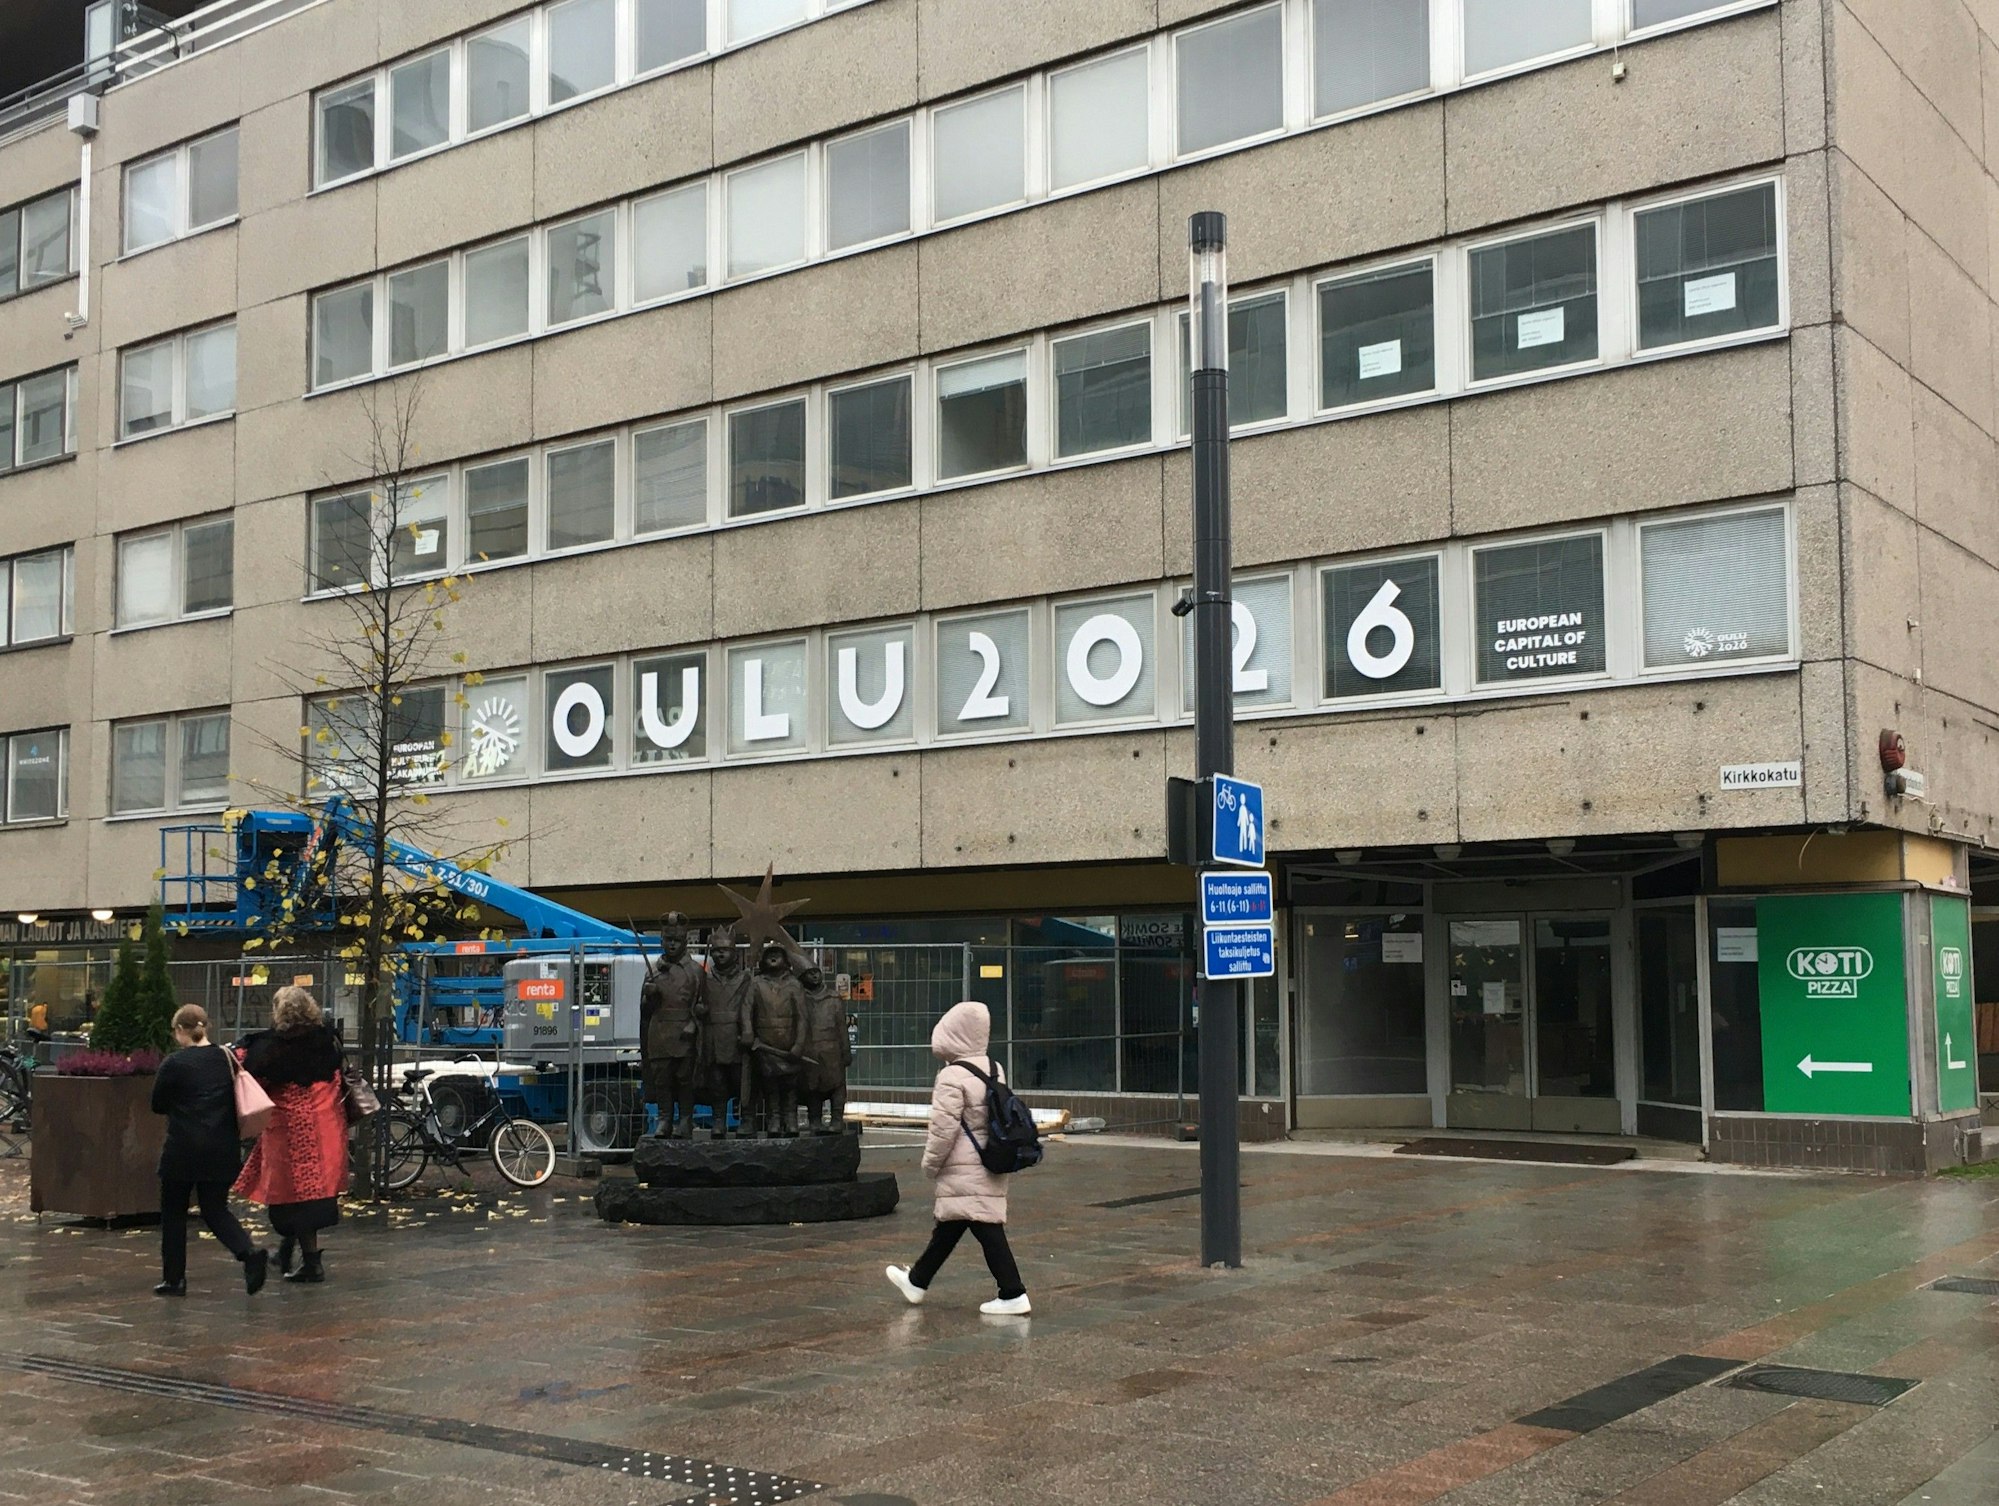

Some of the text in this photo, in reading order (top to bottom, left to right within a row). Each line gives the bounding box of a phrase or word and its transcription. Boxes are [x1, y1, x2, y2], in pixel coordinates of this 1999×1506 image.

[1497, 612, 1582, 634] EUROPEAN
[1494, 631, 1586, 652] CAPITAL OF
[1717, 632, 1747, 642] OULU
[1718, 640, 1748, 651] 2026
[1506, 651, 1577, 670] CULTURE
[1723, 768, 1798, 784] Kirkkokatu
[1208, 883, 1267, 897] Huoltoajo sallittu
[1210, 900, 1226, 912] 6-11
[1227, 899, 1250, 914] (6-11)
[21, 921, 63, 942] LAUKUT
[67, 920, 82, 941] JA
[1211, 931, 1267, 944] Liikuntaesteisten
[462, 944, 481, 954] renta
[1218, 946, 1260, 959] taksikuljetus
[1229, 960, 1252, 972] sallittu
[1797, 952, 1863, 975] KOTI
[1942, 952, 1960, 975] KOTI
[526, 983, 556, 997] renta
[1808, 982, 1852, 994] PIZZA
[1946, 981, 1959, 994] PIZZA
[533, 1025, 558, 1036] 91896
